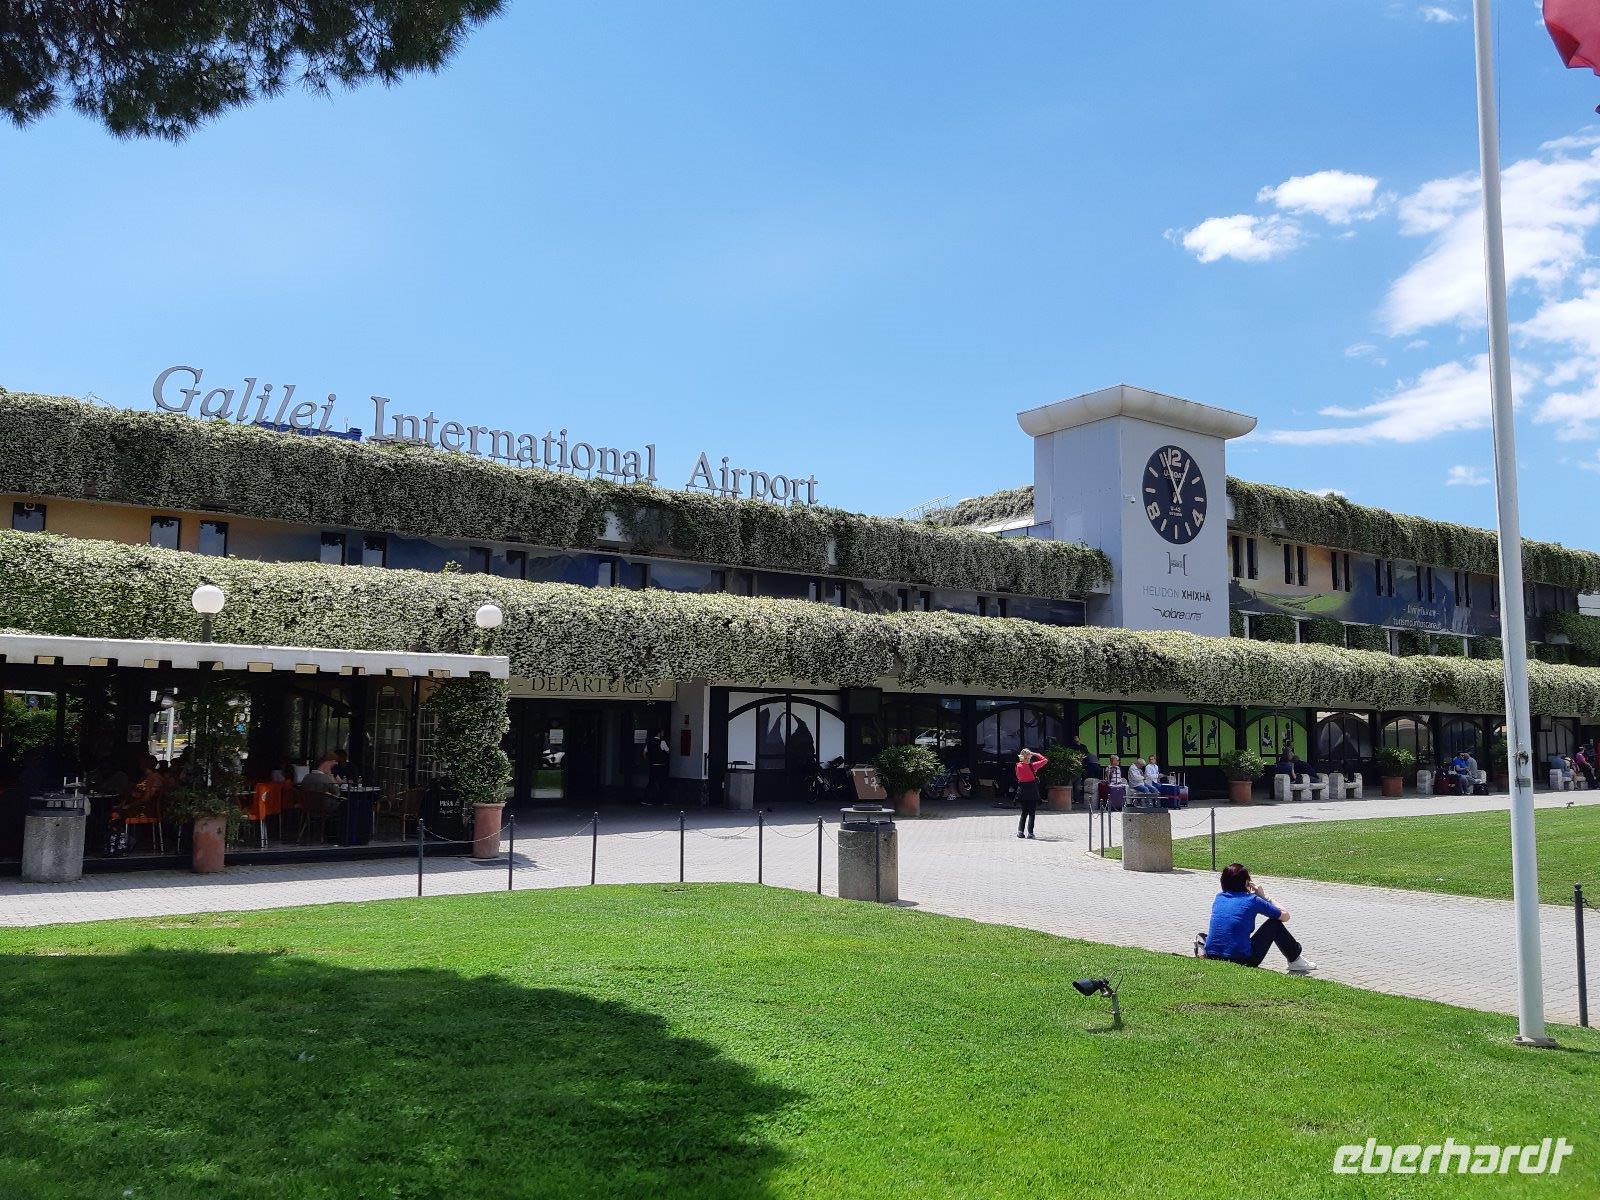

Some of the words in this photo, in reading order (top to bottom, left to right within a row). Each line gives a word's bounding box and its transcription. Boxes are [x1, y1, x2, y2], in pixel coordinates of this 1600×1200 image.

[152, 365, 337, 433] Galilei
[370, 395, 658, 482] International
[685, 451, 819, 505] Airport
[531, 676, 655, 695] DEPARTURES
